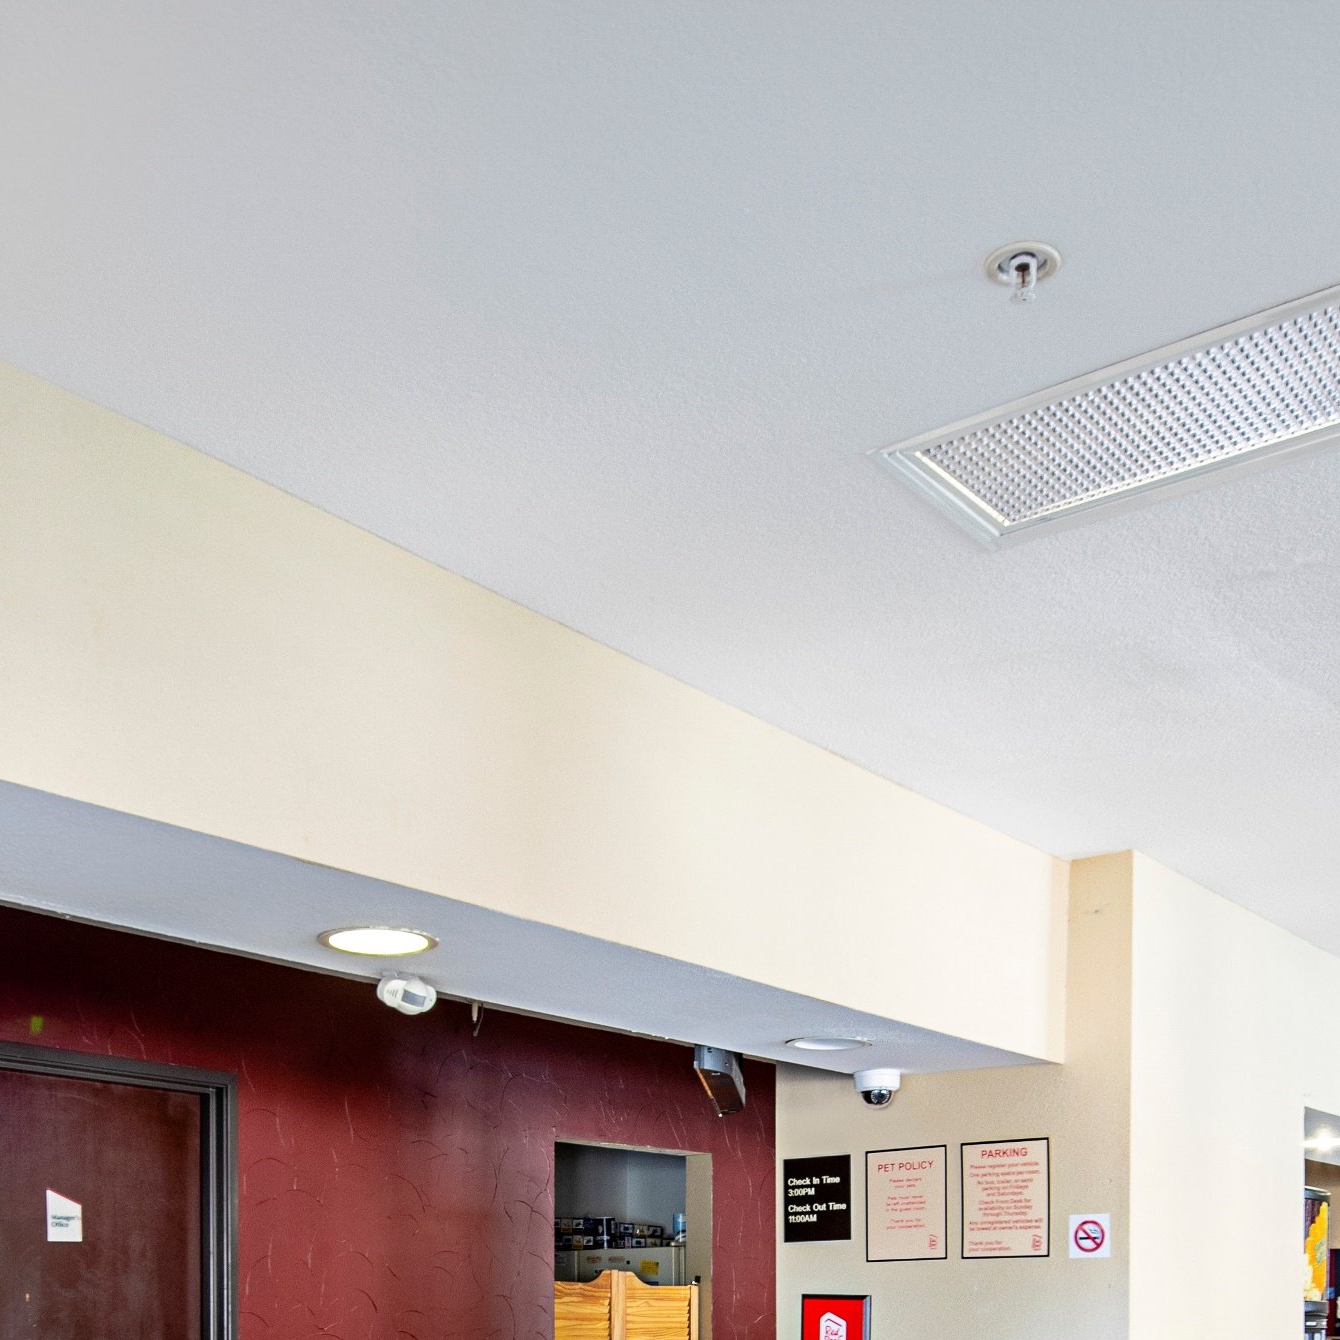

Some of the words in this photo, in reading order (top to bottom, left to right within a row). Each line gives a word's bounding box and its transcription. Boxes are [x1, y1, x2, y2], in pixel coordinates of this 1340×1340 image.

[981, 1147, 1028, 1158] PARKING
[877, 1163, 895, 1172] PET
[898, 1160, 934, 1171] POLICY
[787, 1177, 811, 1186] Check
[812, 1176, 820, 1185] In
[821, 1175, 841, 1184] Time
[787, 1187, 815, 1197] 3:00PM
[788, 1203, 811, 1213] Check
[812, 1203, 827, 1212] Out
[828, 1202, 847, 1211] Time
[788, 1214, 818, 1223] 11:00AM
[825, 1325, 840, 1336] Red
